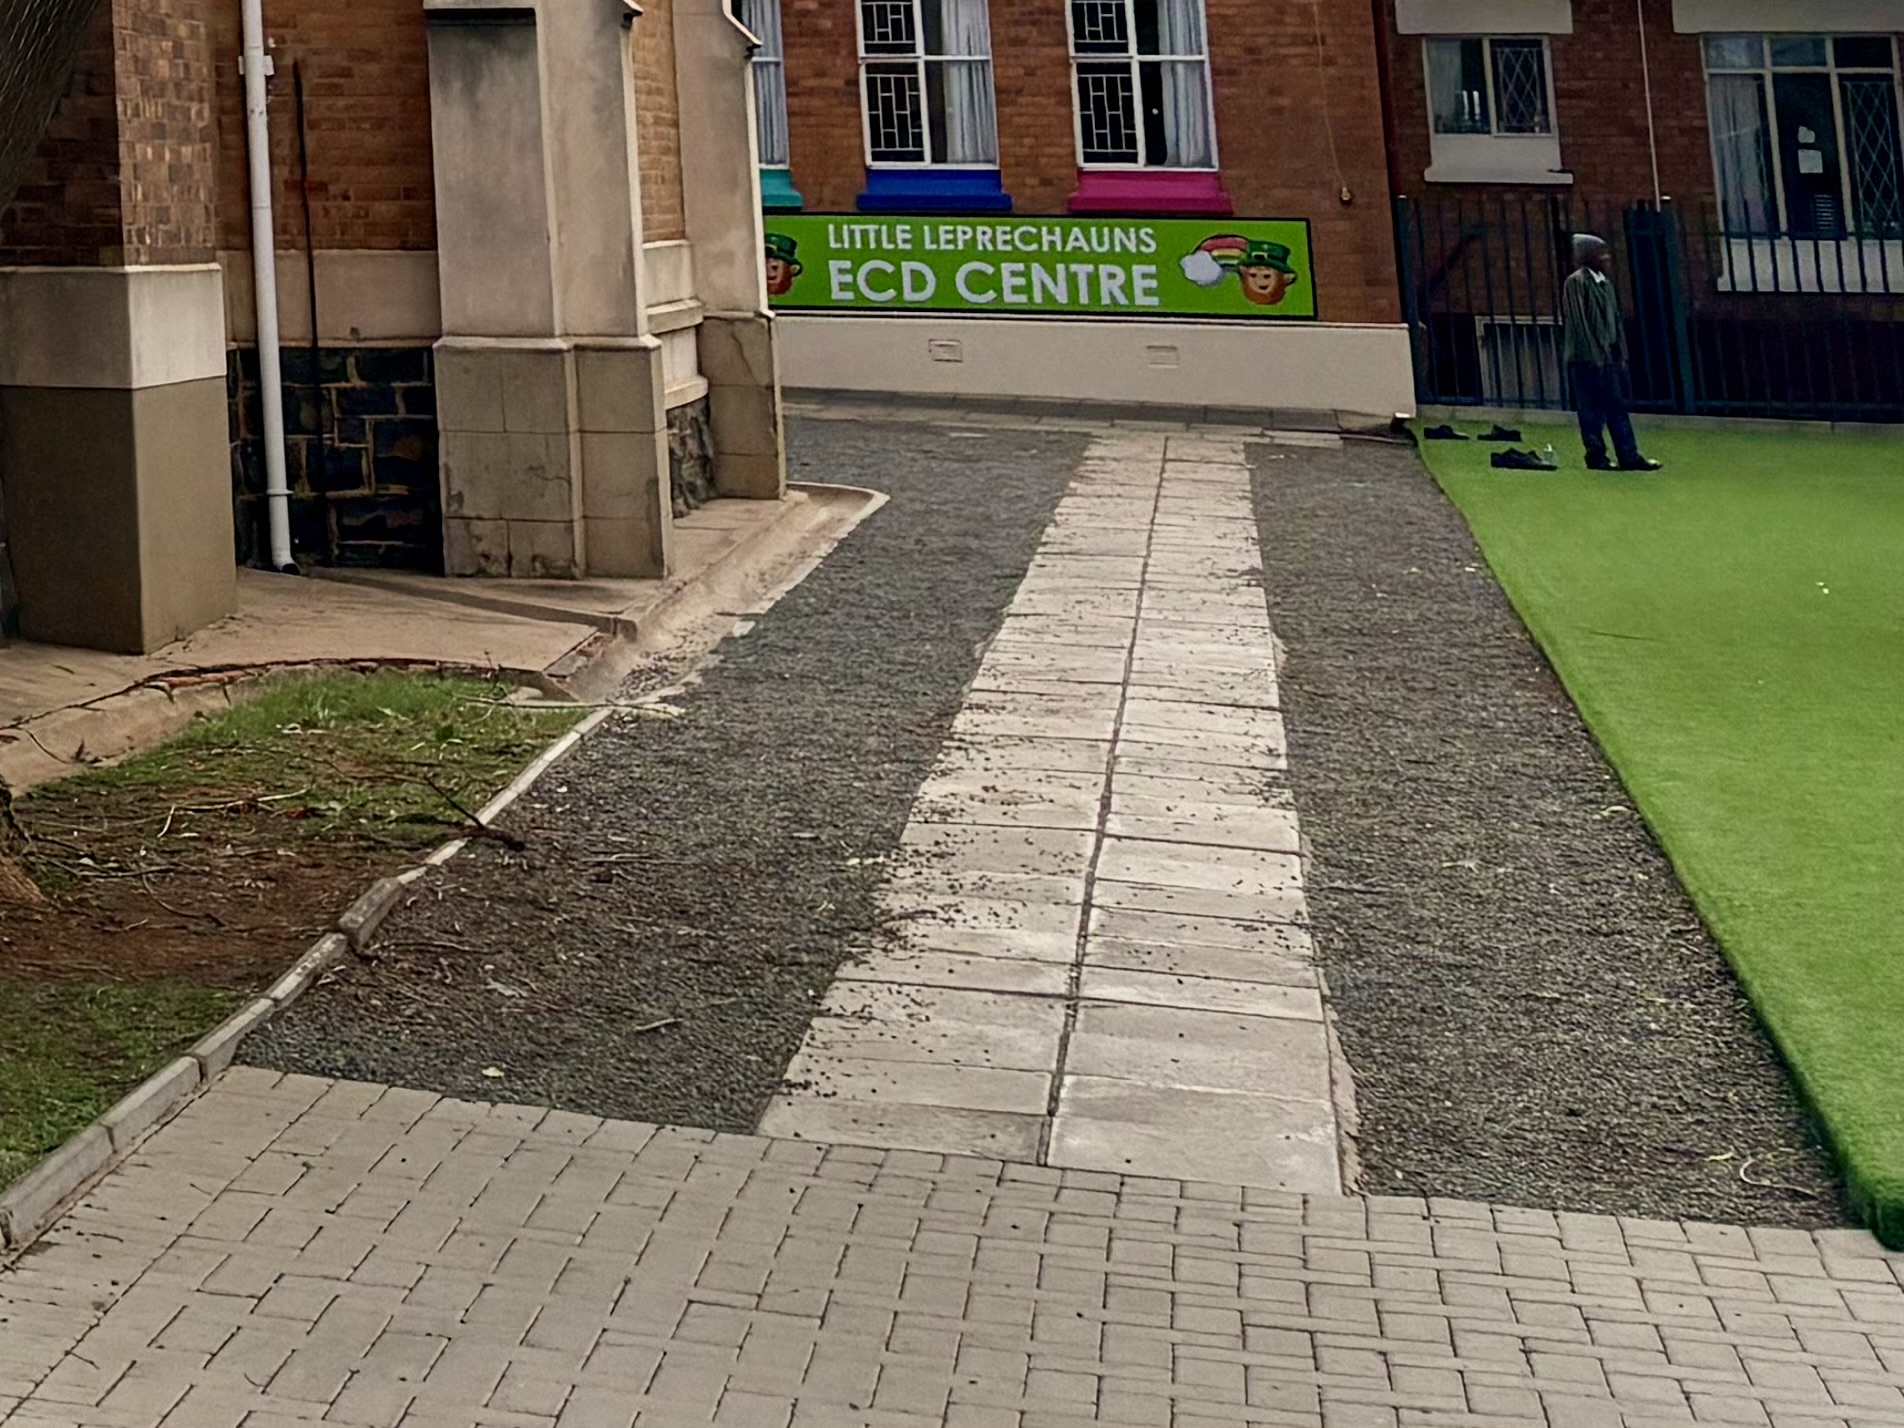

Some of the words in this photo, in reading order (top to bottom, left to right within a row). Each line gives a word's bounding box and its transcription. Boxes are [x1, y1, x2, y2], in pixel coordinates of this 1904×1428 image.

[827, 223, 913, 250] LITTLE
[923, 224, 1157, 254] LEPRECHAUNS
[828, 259, 937, 302] ECD
[954, 260, 1160, 307] CENTRE
